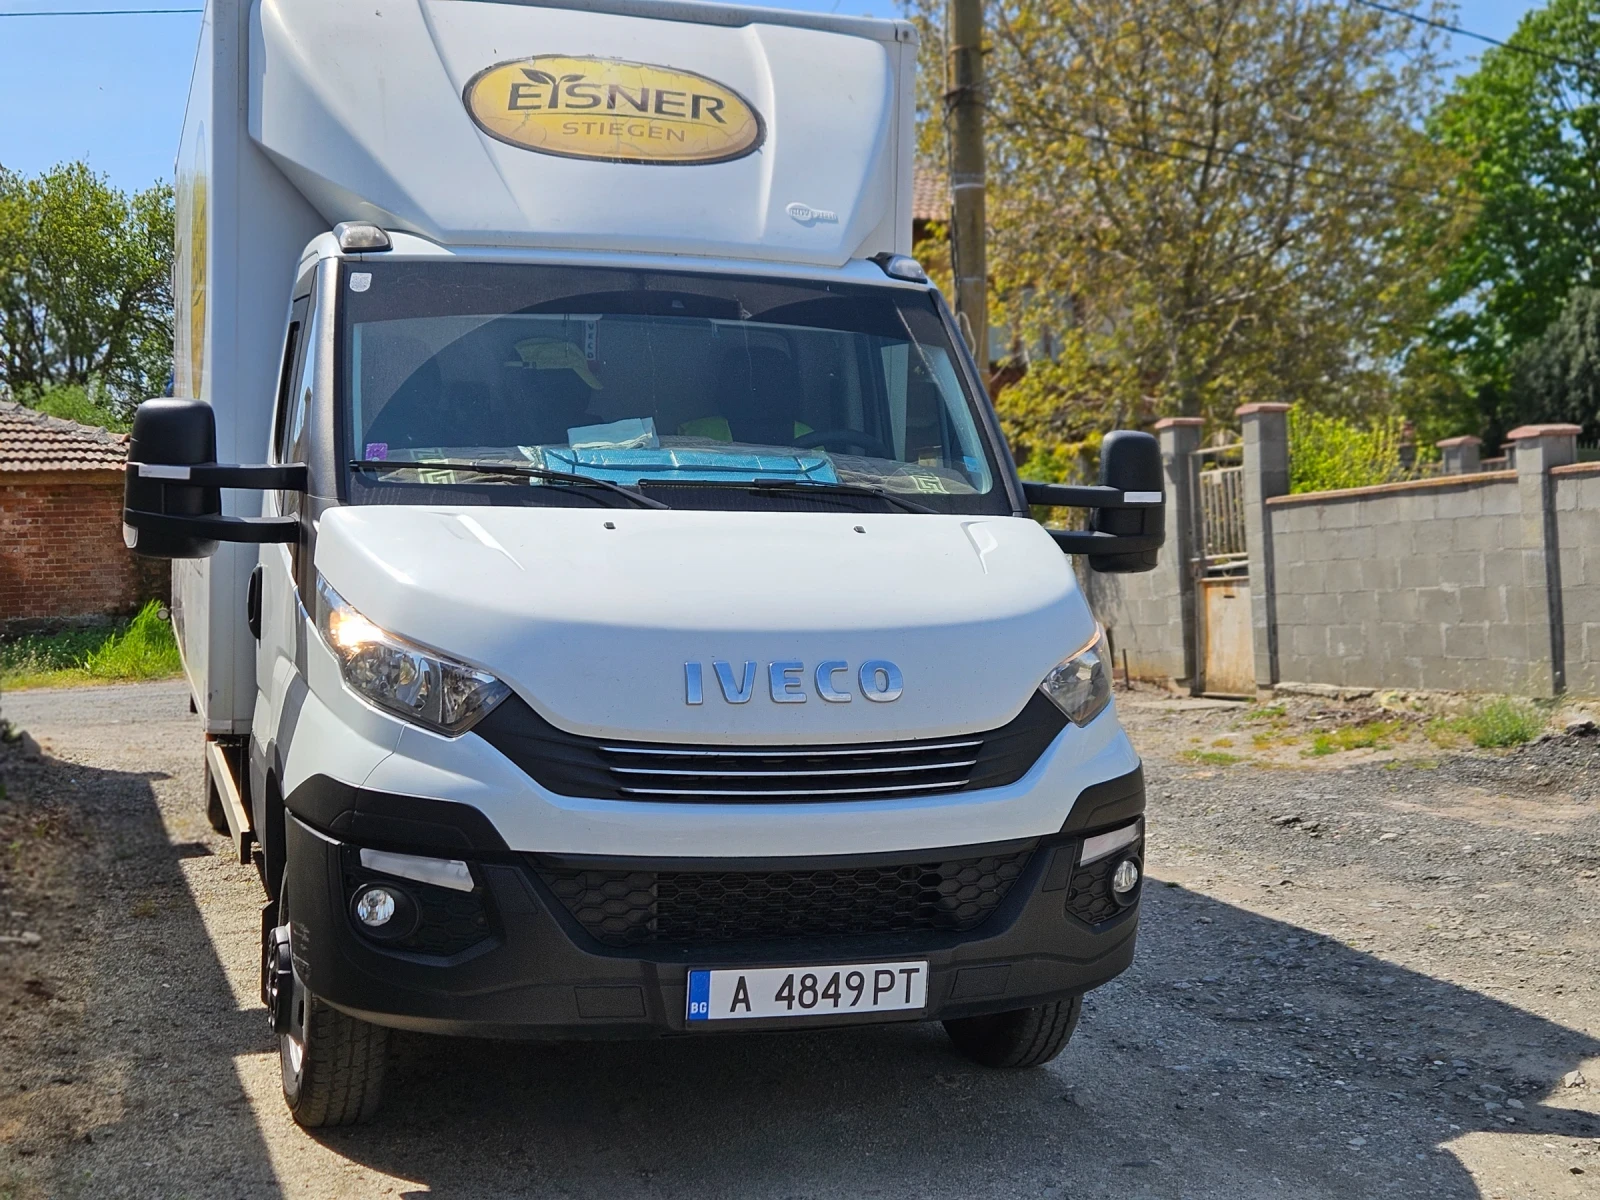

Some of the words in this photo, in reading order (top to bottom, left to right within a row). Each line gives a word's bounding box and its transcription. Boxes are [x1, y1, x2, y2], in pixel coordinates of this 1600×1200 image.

[562, 121, 685, 143] STIEGEN
[587, 322, 595, 359] VECO
[684, 660, 904, 705] IVECO
[690, 1001, 707, 1014] BG
[730, 976, 752, 1013] A
